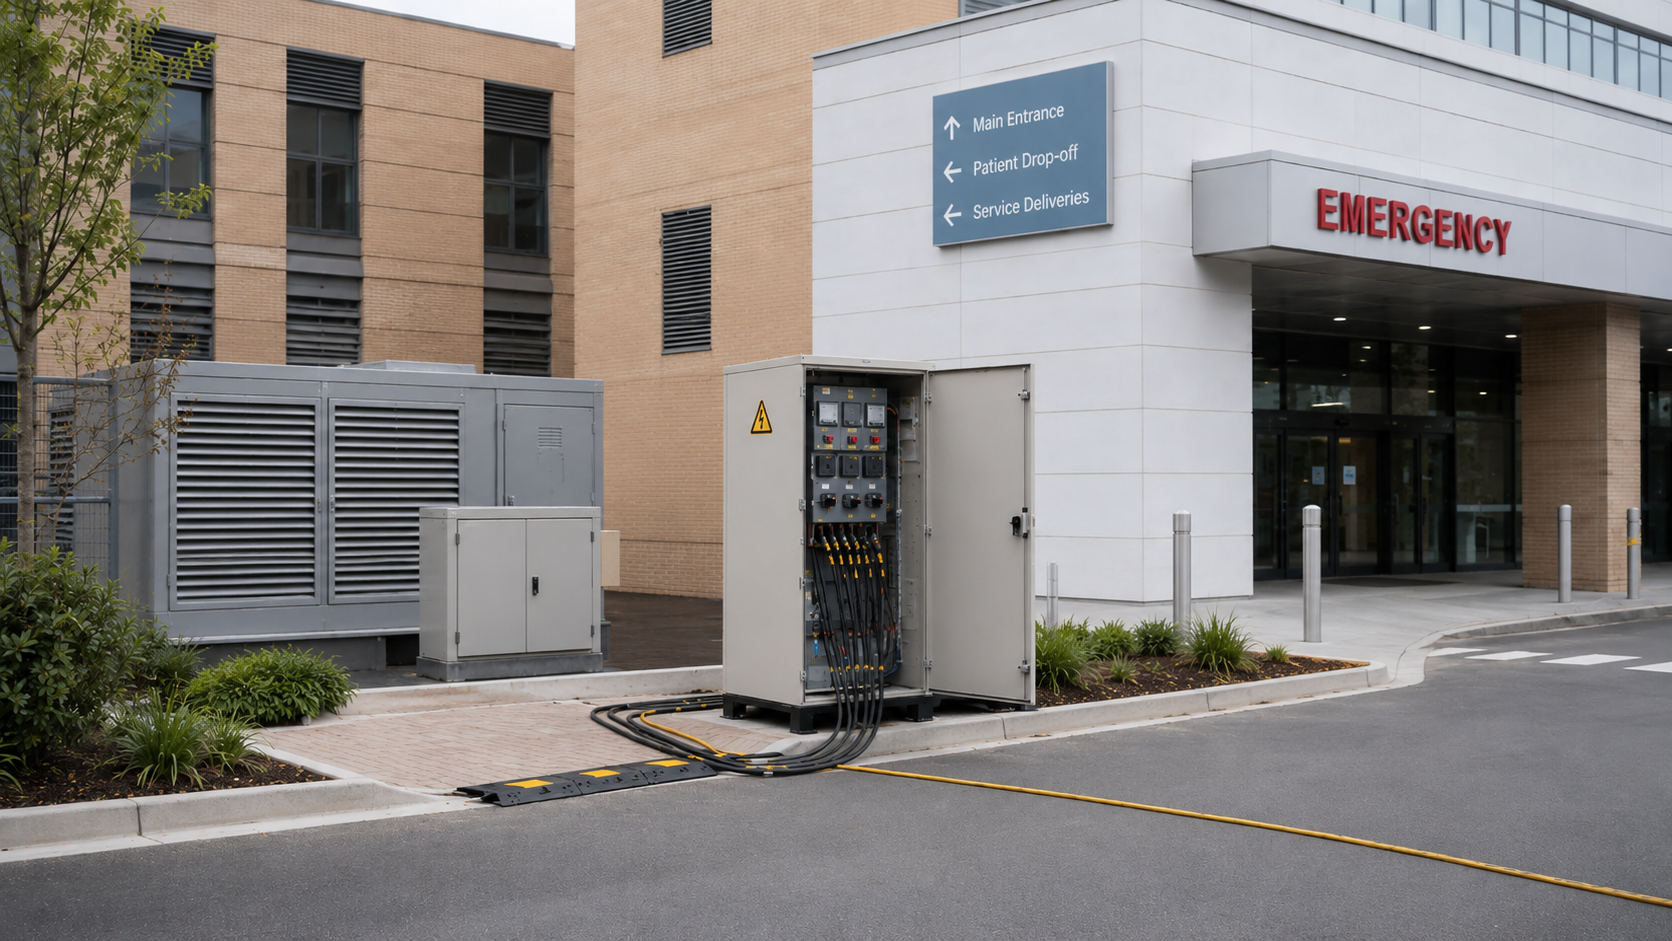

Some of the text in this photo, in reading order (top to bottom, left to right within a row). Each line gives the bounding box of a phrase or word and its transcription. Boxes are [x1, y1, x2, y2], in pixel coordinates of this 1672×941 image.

[973, 105, 1065, 133] Main Entrance
[973, 143, 1079, 176] Patient Drop-off
[973, 190, 1090, 220] Service Deliveries
[1317, 188, 1512, 256] EMERGENCY
